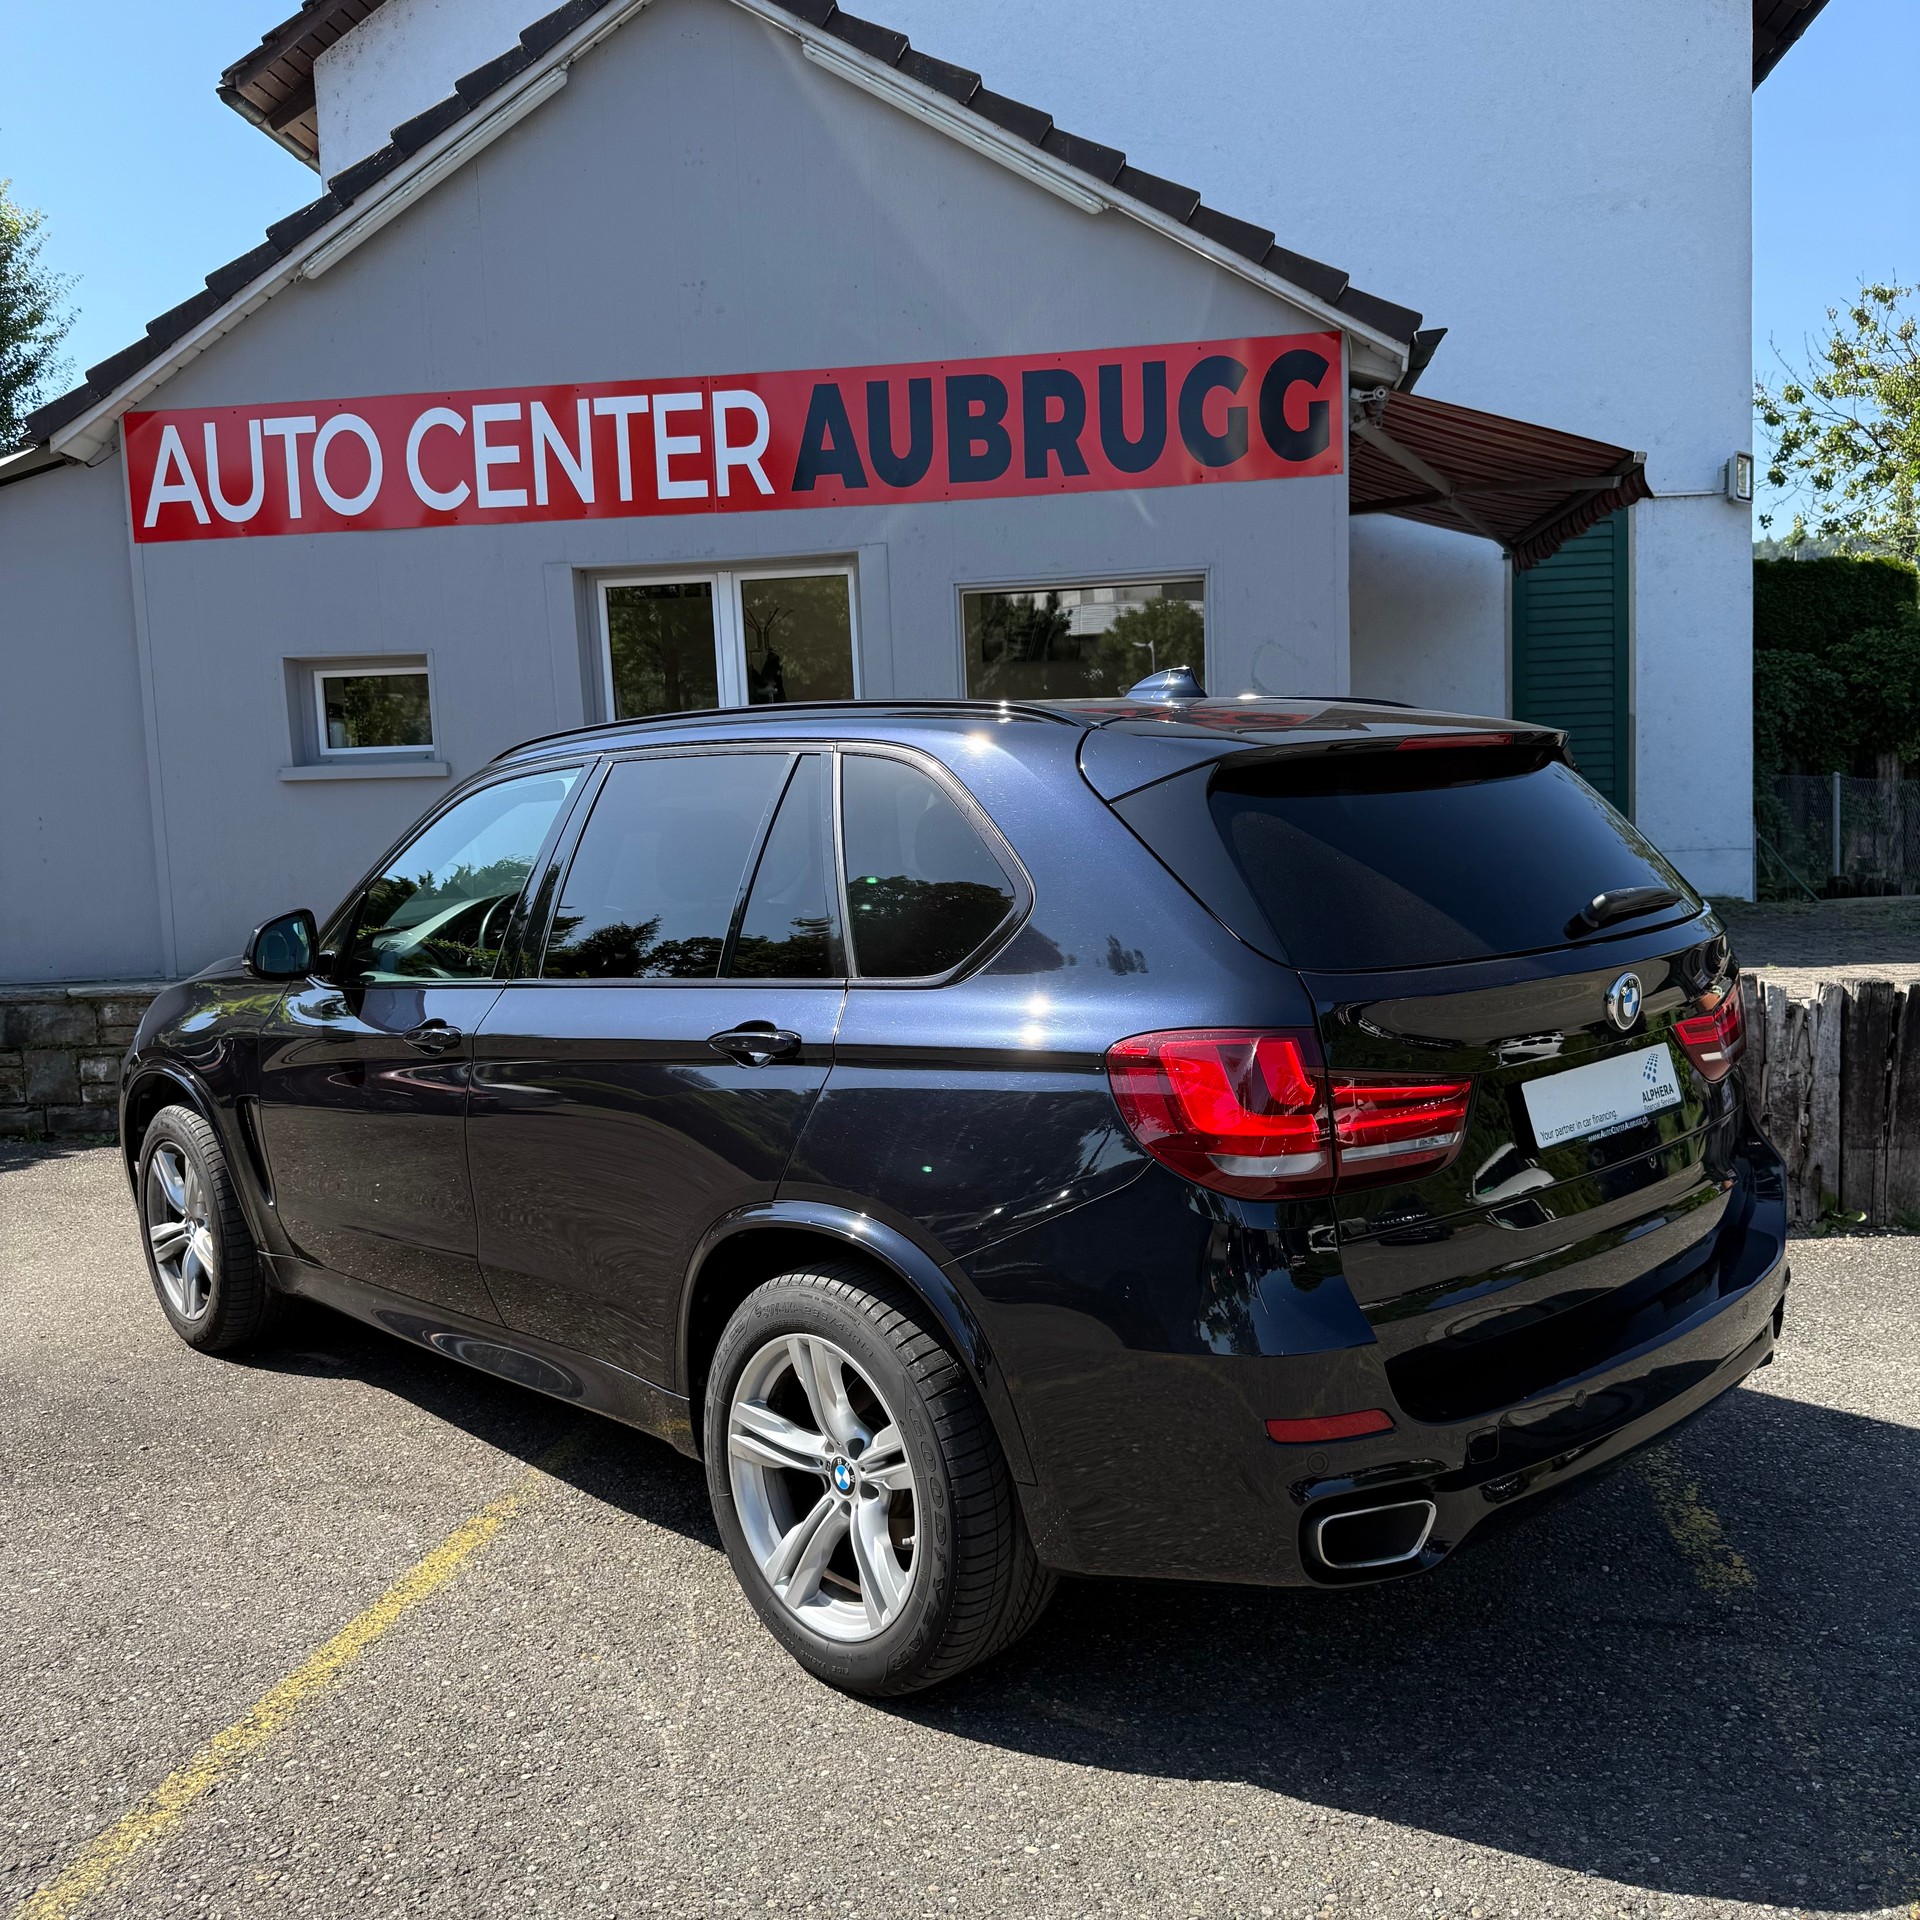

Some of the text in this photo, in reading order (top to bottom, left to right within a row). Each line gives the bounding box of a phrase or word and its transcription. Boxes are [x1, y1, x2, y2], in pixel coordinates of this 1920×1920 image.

[144, 349, 1330, 528] AUTO CENTER AUBRUGG
[1642, 1083, 1675, 1103] ALPHERA
[1643, 1096, 1677, 1112] Financial Services
[1540, 1109, 1618, 1141] Your partner in car financing.
[836, 1458, 855, 1483] BMW
